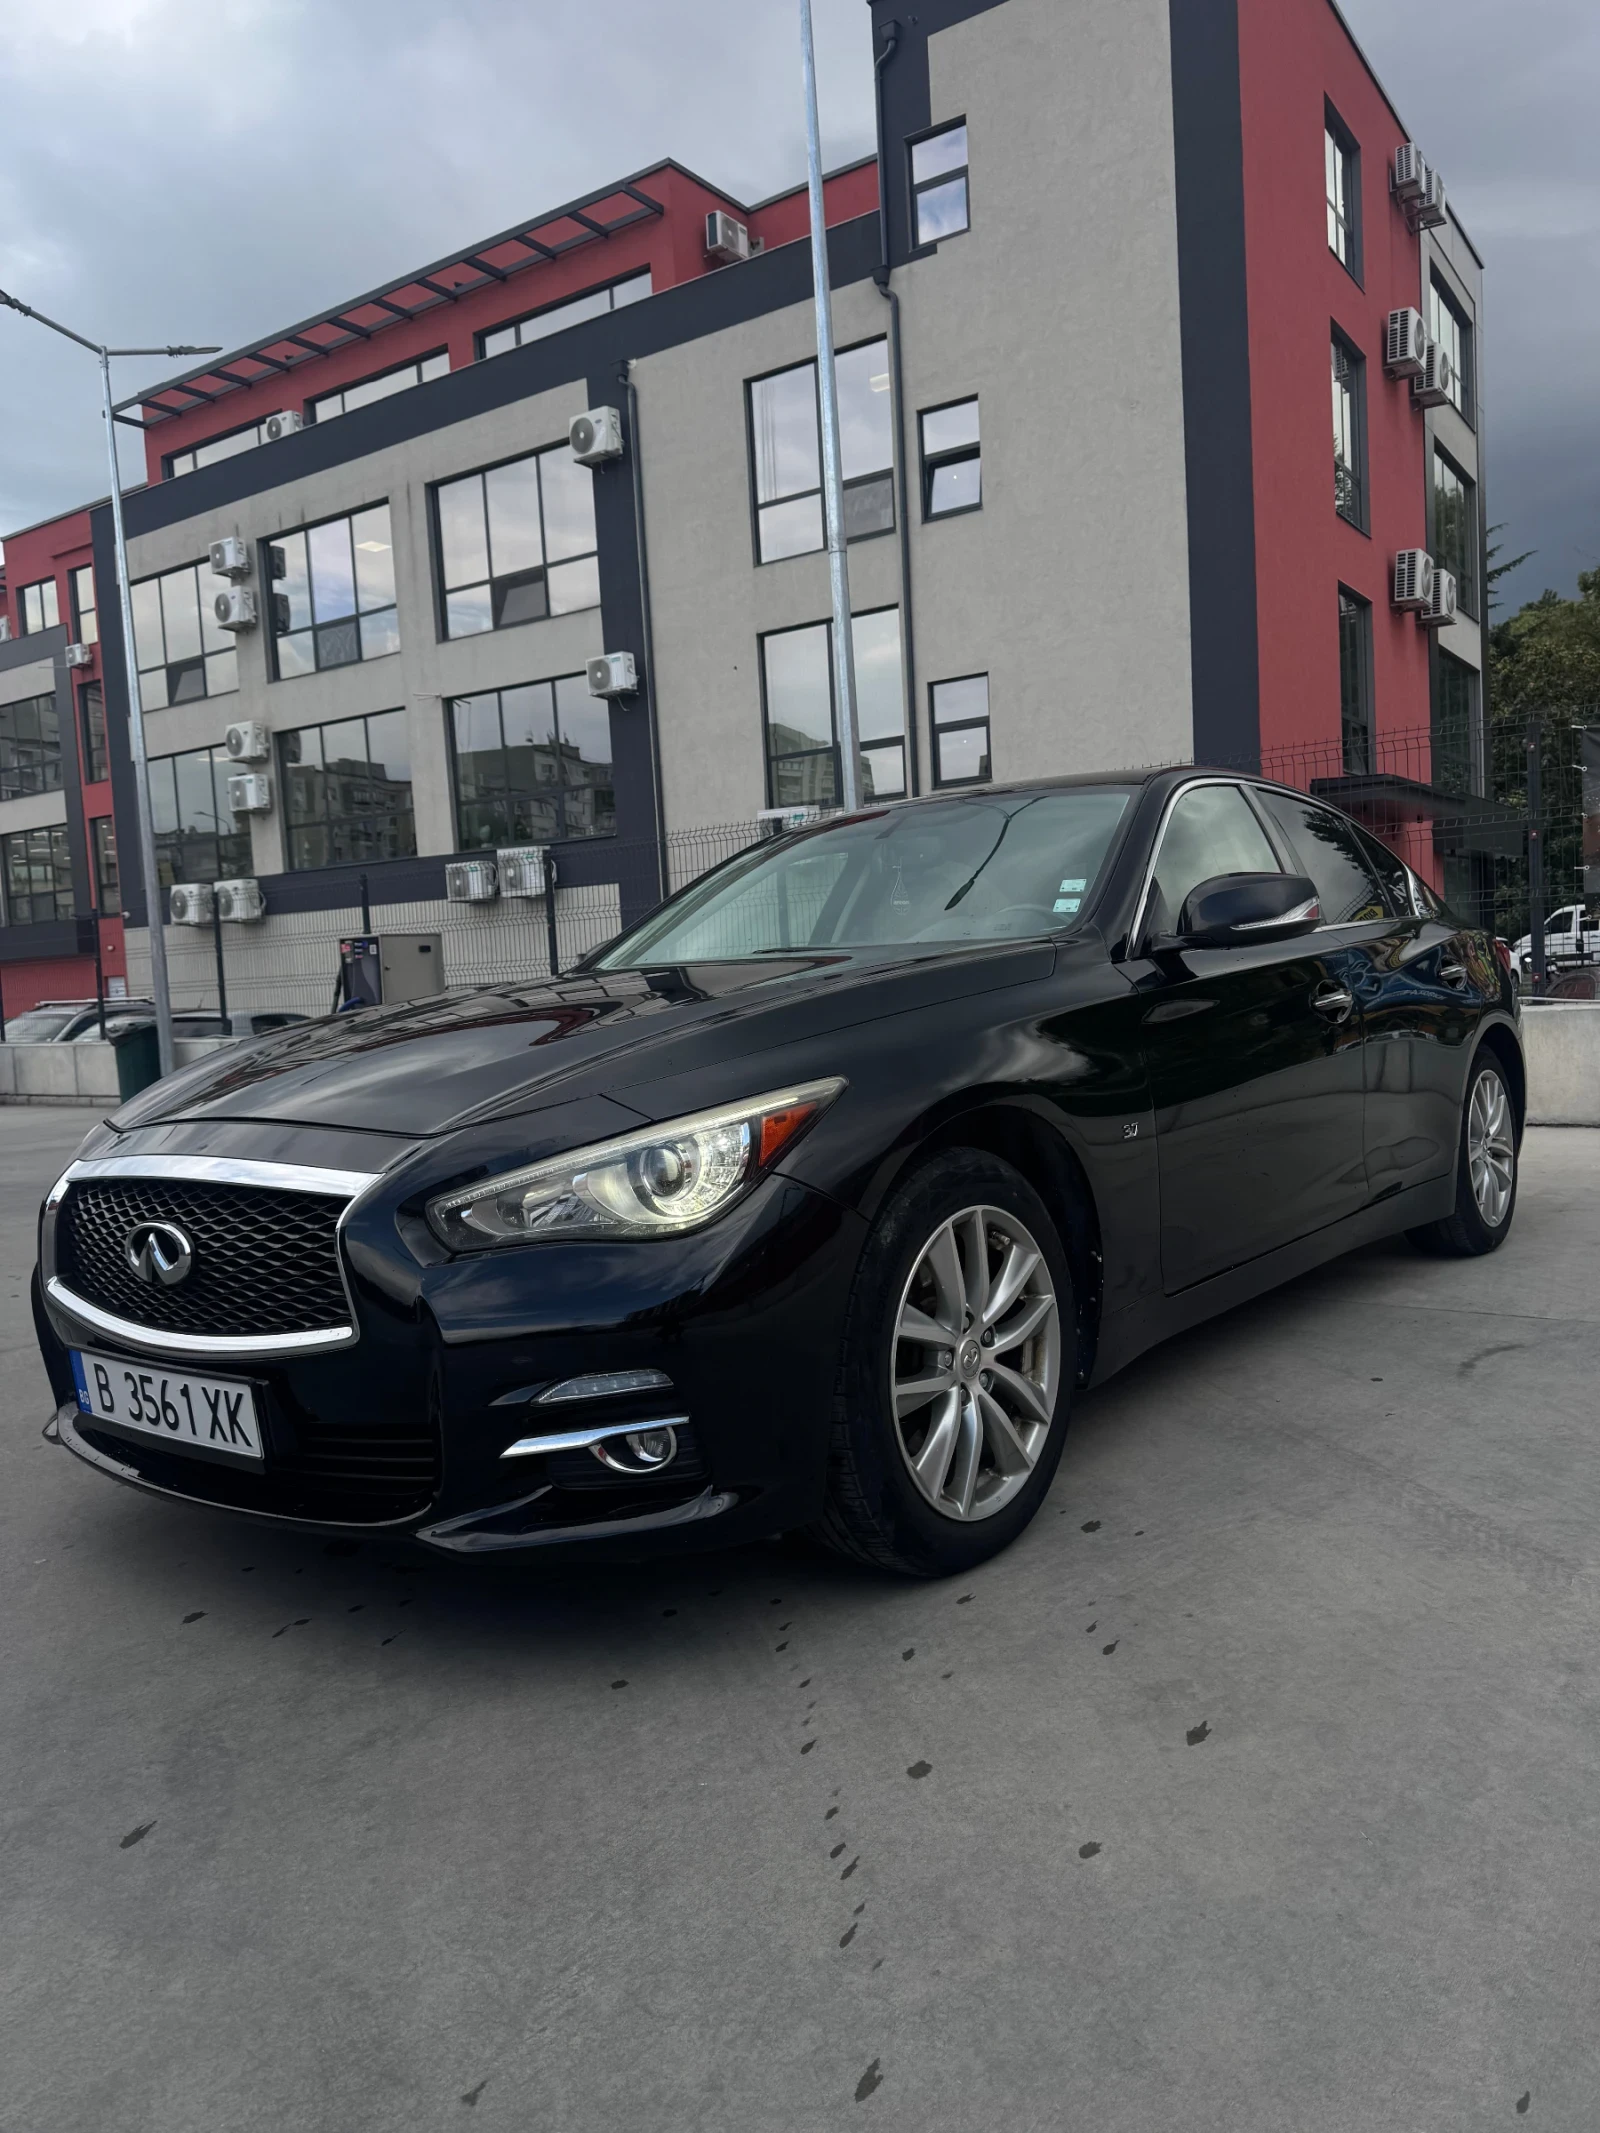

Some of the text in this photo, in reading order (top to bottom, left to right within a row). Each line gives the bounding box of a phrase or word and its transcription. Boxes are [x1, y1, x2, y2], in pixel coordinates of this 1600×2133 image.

[79, 1389, 90, 1404] BG
[94, 1363, 253, 1447] B 3561 XK
